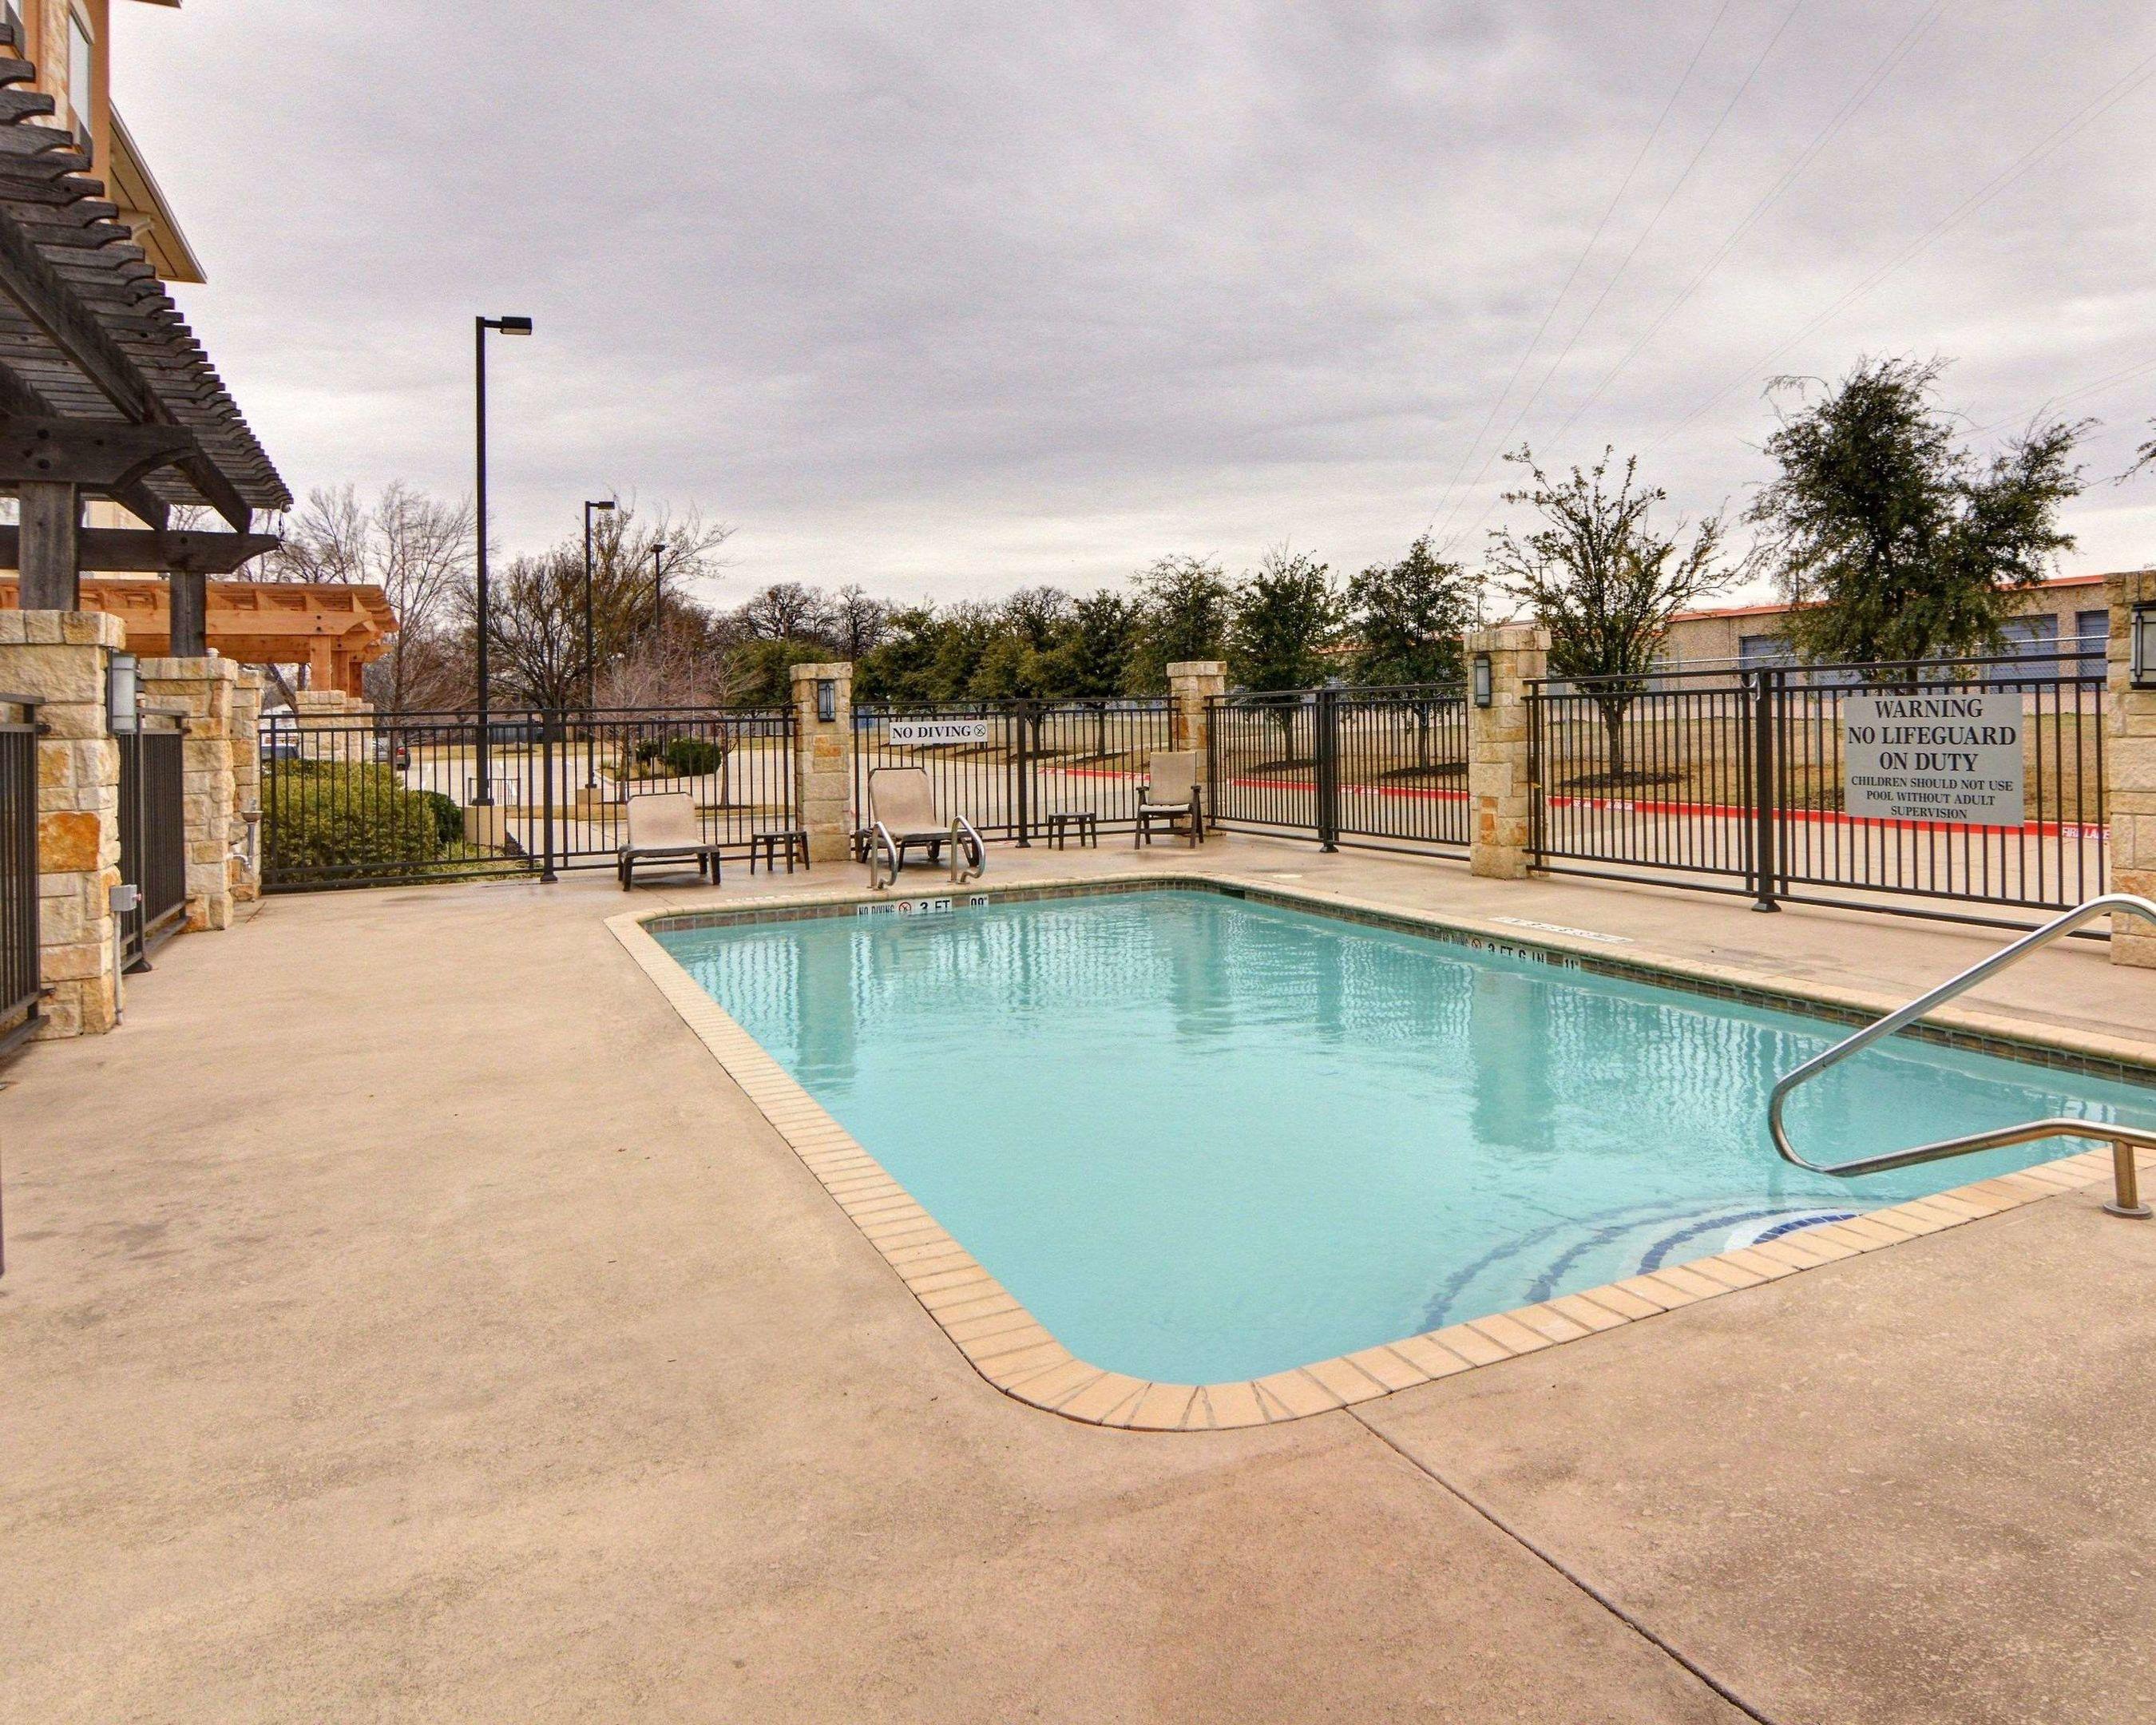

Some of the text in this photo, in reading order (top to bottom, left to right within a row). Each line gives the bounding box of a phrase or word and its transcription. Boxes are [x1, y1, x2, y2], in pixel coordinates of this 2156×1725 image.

[1876, 699, 1984, 719] WARNING
[893, 725, 971, 739] NO DIVING
[1849, 727, 2016, 745] NO LIFEGUARD
[1880, 752, 1979, 772] ON DUTY
[1851, 775, 2014, 791] CHILDREN SHOULD NOT USE
[1866, 791, 1996, 806] POOL WITHOUT ADULT
[1891, 806, 1968, 819] SUPERVISION
